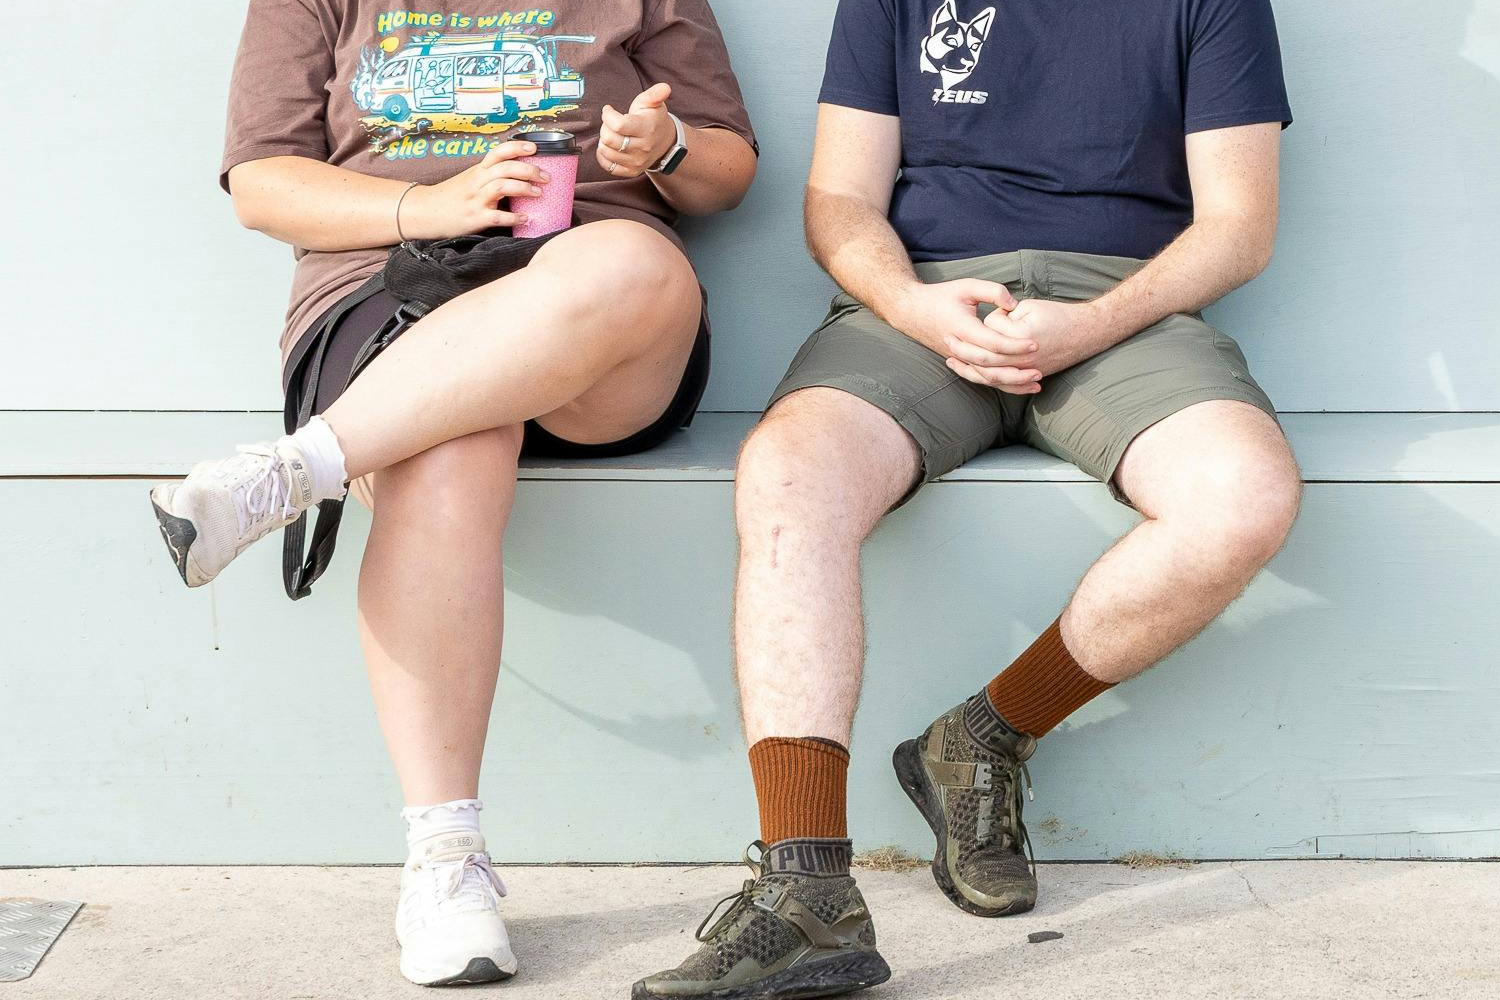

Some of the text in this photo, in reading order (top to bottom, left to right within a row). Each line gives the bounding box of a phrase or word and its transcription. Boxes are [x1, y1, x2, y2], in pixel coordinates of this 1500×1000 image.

[377, 8, 554, 33] Home is where
[932, 88, 989, 107] ZEUS
[387, 135, 429, 158] she
[779, 844, 850, 873] PUMA
